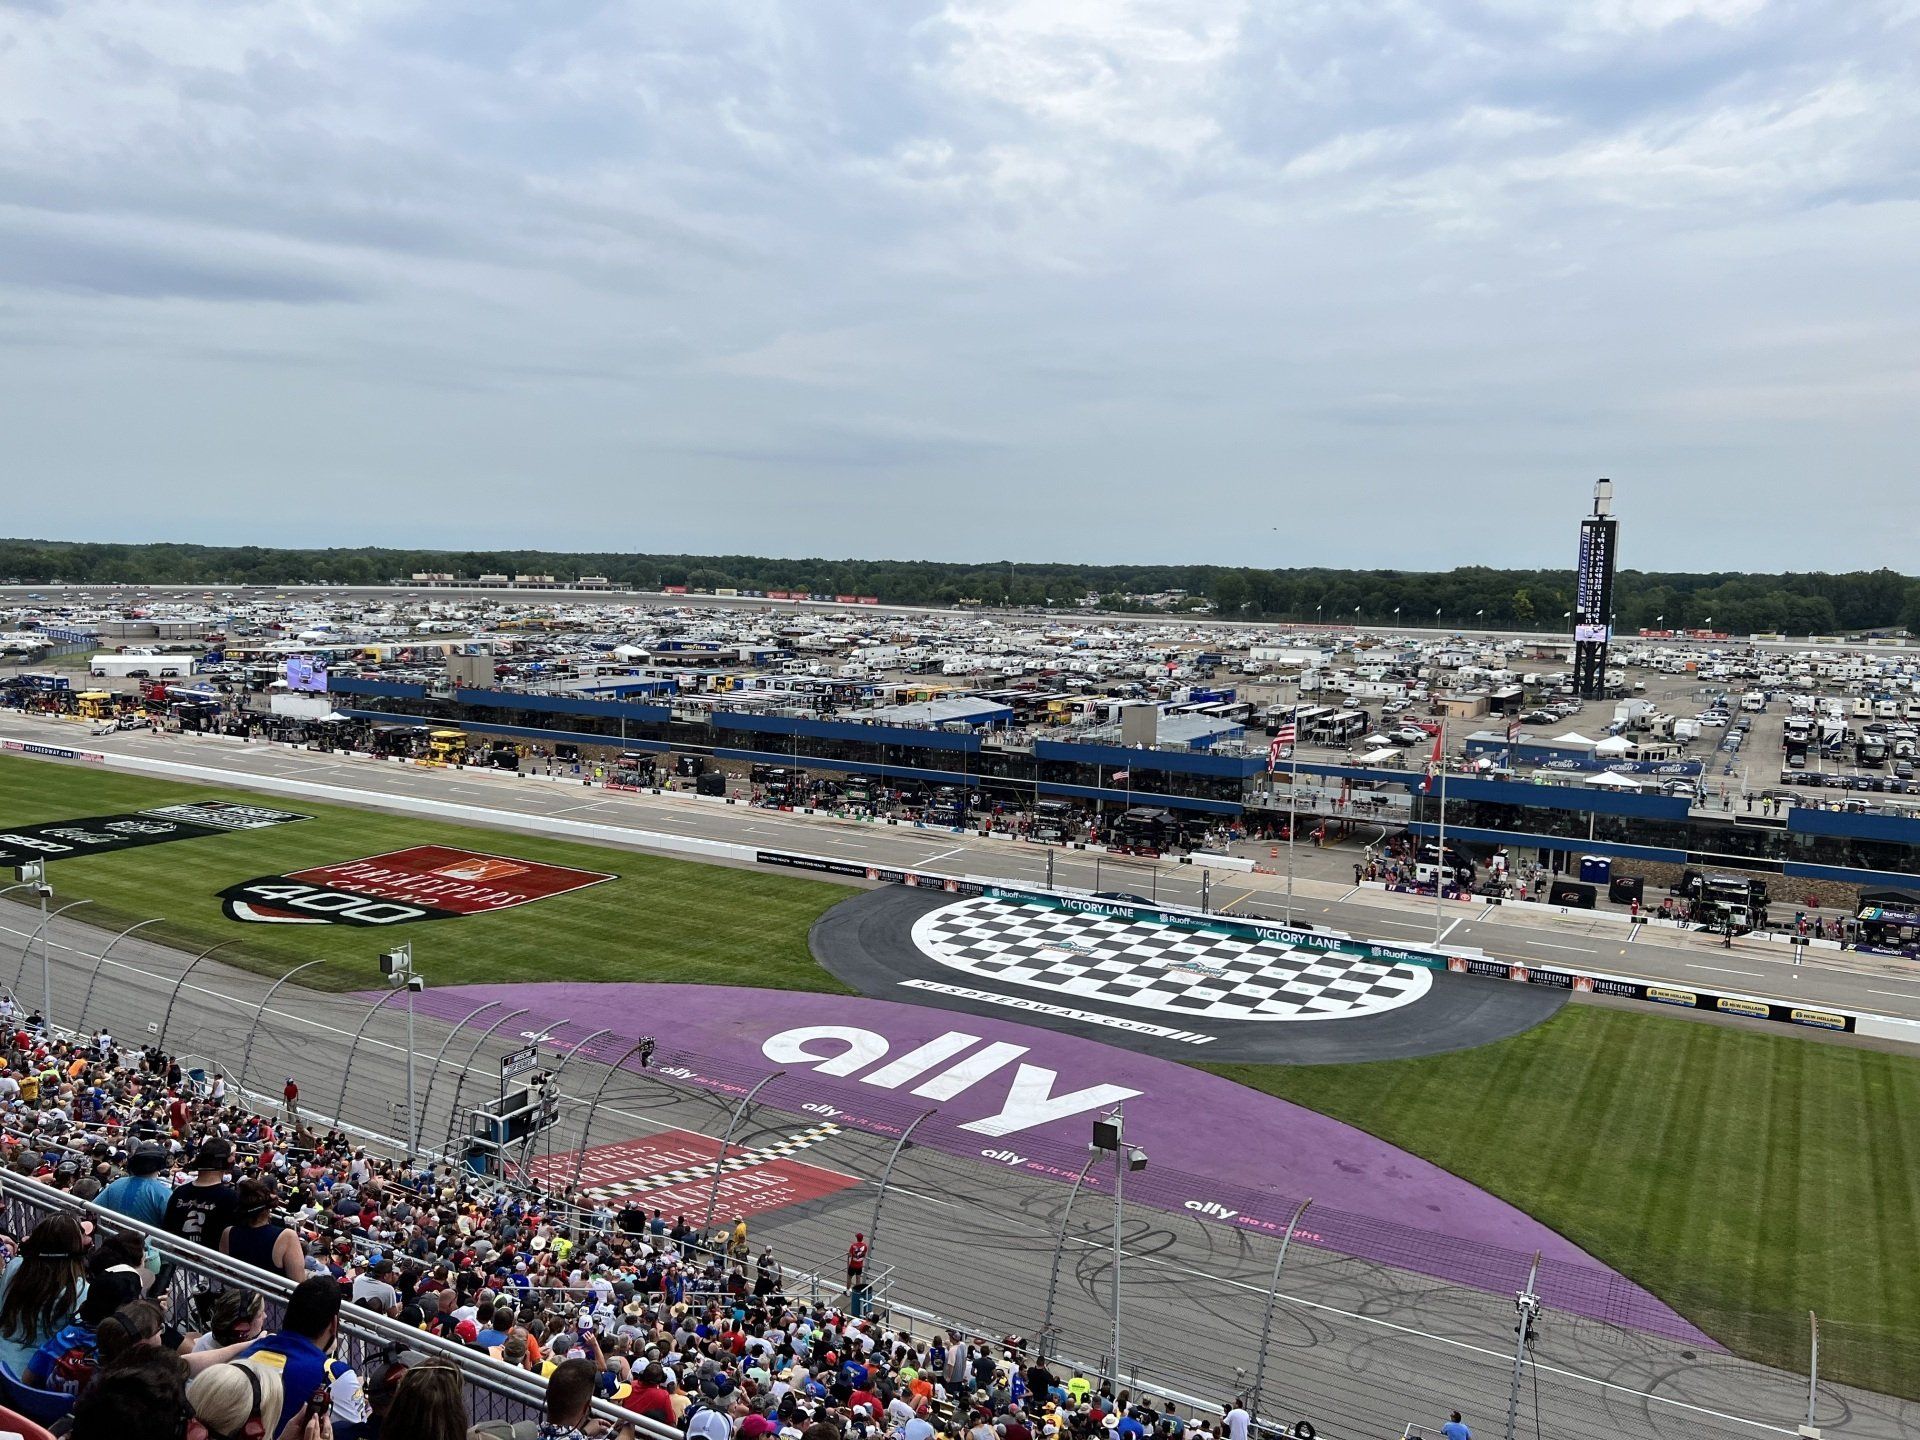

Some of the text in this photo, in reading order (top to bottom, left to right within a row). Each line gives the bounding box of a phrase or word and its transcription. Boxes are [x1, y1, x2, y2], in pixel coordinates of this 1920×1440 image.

[25, 745, 72, 758] MISPEEDWAY.com
[324, 863, 527, 906] FIREKEEPERS
[325, 880, 440, 905] CASINO
[1000, 889, 1020, 899] Ruoff
[242, 885, 427, 923] 400
[1060, 898, 1134, 918] VICTORY LANE
[1169, 914, 1191, 925] Ruoff
[1255, 928, 1341, 950] VICTORY LANE
[1382, 949, 1408, 960] Ruoff
[1468, 961, 1507, 974] FIREKEEPERS
[1530, 970, 1570, 984] FIREKEEPERS
[1594, 980, 1636, 994] FIREKEEPERS
[914, 981, 1159, 1033] MISPEEDWAY.com
[1817, 1016, 1842, 1024] HOLLAND
[660, 1067, 698, 1079] ally
[761, 1025, 1144, 1138] ally
[801, 1103, 844, 1117] ally
[981, 1149, 1028, 1166] ally
[1026, 1162, 1045, 1170] do
[1046, 1166, 1059, 1174] it
[739, 1187, 796, 1204] HOTEL
[182, 1210, 206, 1233] 2
[1184, 1200, 1238, 1220] ally
[1239, 1216, 1260, 1226] do
[1262, 1221, 1276, 1230] it
